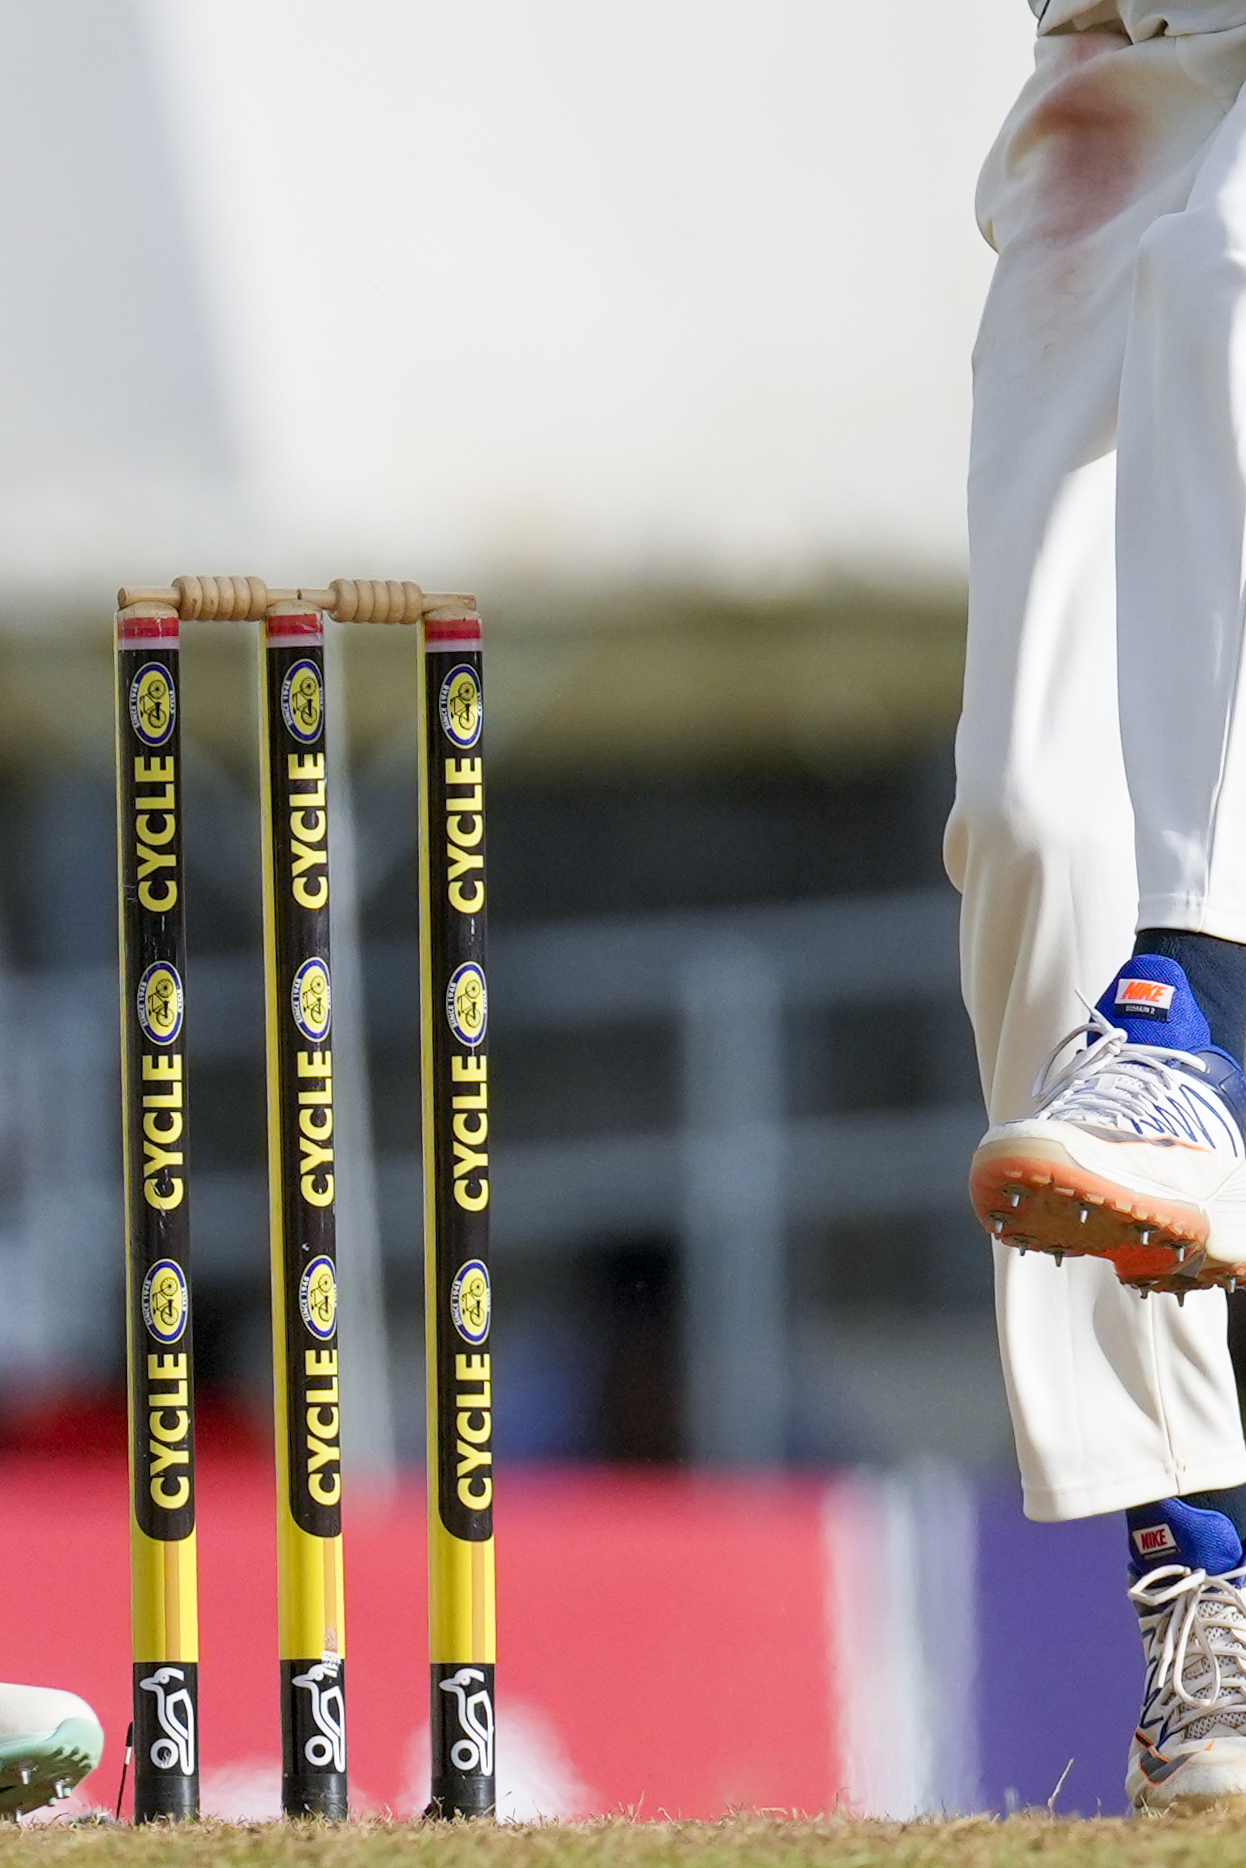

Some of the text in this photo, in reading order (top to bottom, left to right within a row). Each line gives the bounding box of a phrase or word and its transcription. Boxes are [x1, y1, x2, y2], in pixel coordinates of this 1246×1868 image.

[136, 757, 178, 912] CYCLE
[288, 754, 329, 910] CYCLE
[446, 758, 485, 914] CYCLE
[1121, 982, 1168, 1002] NIKE
[143, 1055, 184, 1211] CYCLE
[298, 1052, 335, 1207] CYCLE
[452, 1056, 489, 1212] CYCLE
[148, 1353, 190, 1510] CYCLE
[306, 1350, 343, 1506] CYCLE
[456, 1354, 493, 1511] CYCLE
[1141, 1528, 1168, 1550] NIKE
